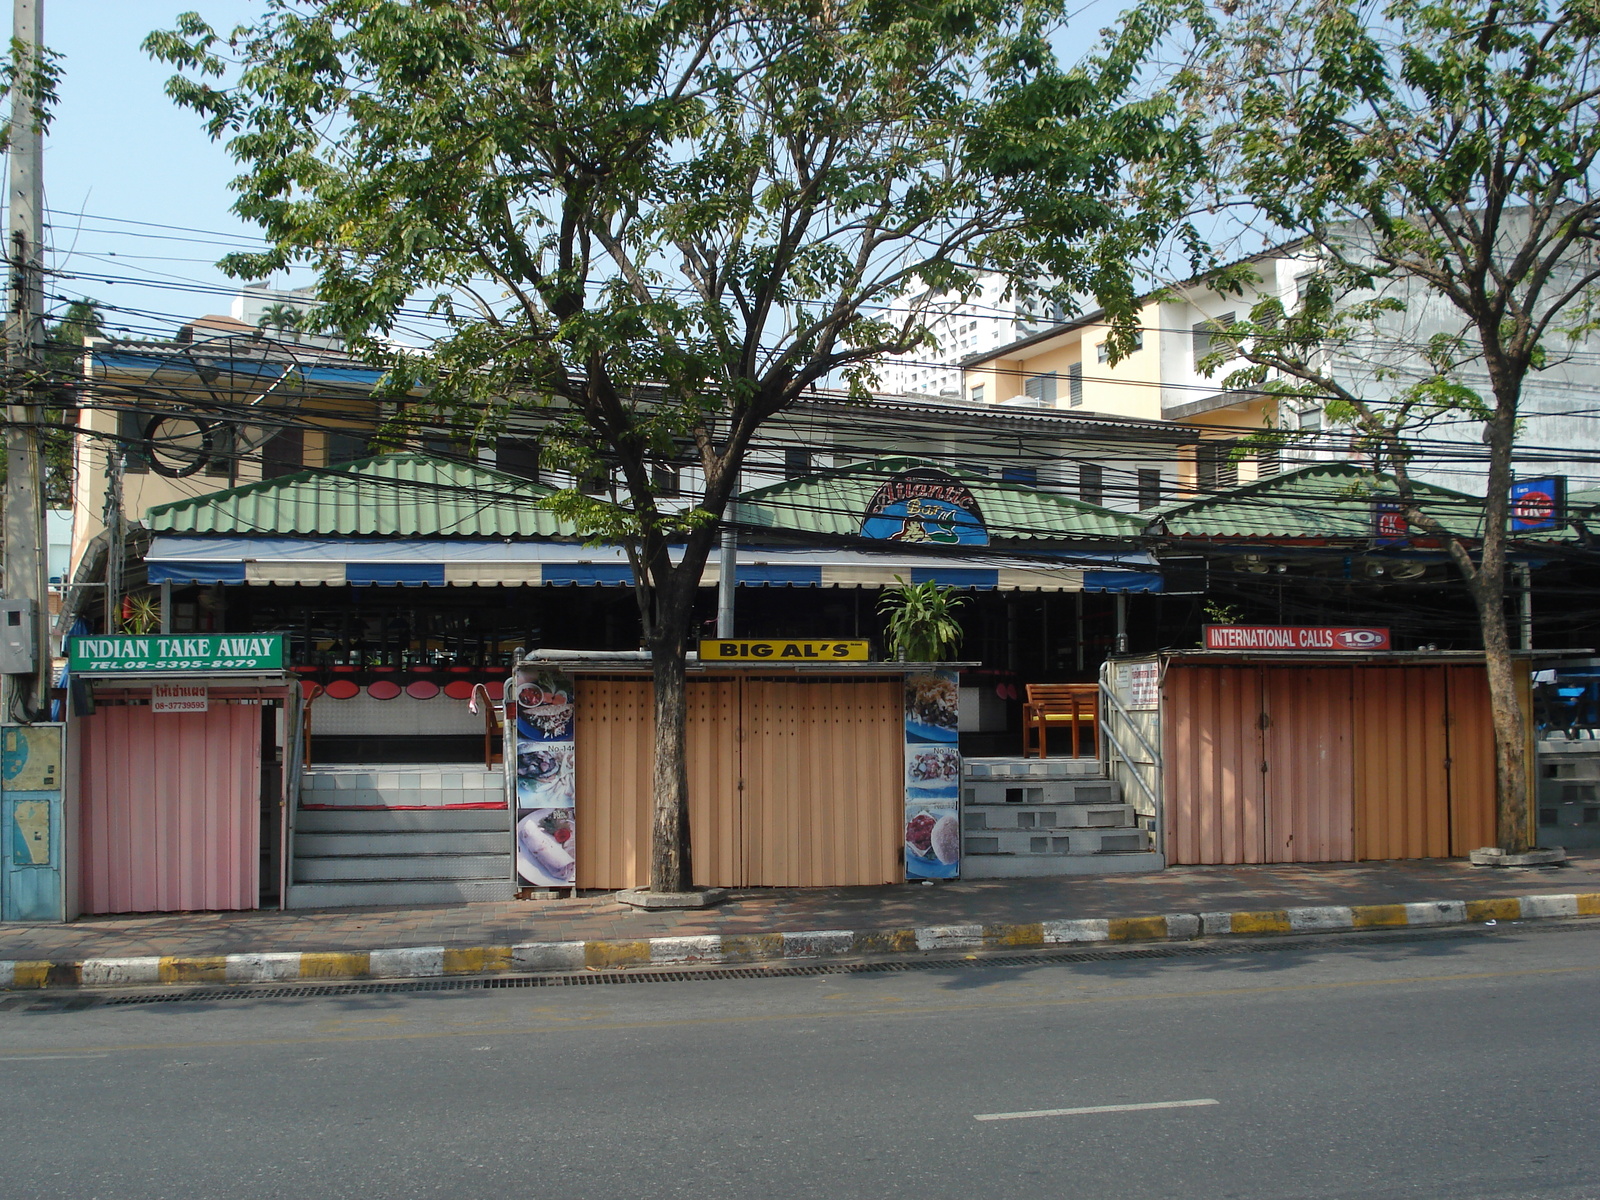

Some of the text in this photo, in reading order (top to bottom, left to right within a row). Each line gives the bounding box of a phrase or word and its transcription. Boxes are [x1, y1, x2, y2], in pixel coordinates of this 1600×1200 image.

[873, 482, 974, 514] Atlantic
[906, 498, 944, 516] Bar
[1211, 628, 1295, 647] INTERNATIONAL
[1299, 629, 1334, 648] CALLS
[78, 638, 275, 659] INDIAN TAKE AWAY
[719, 643, 851, 658] BIG AL'S
[154, 701, 206, 710] 08-37739595
